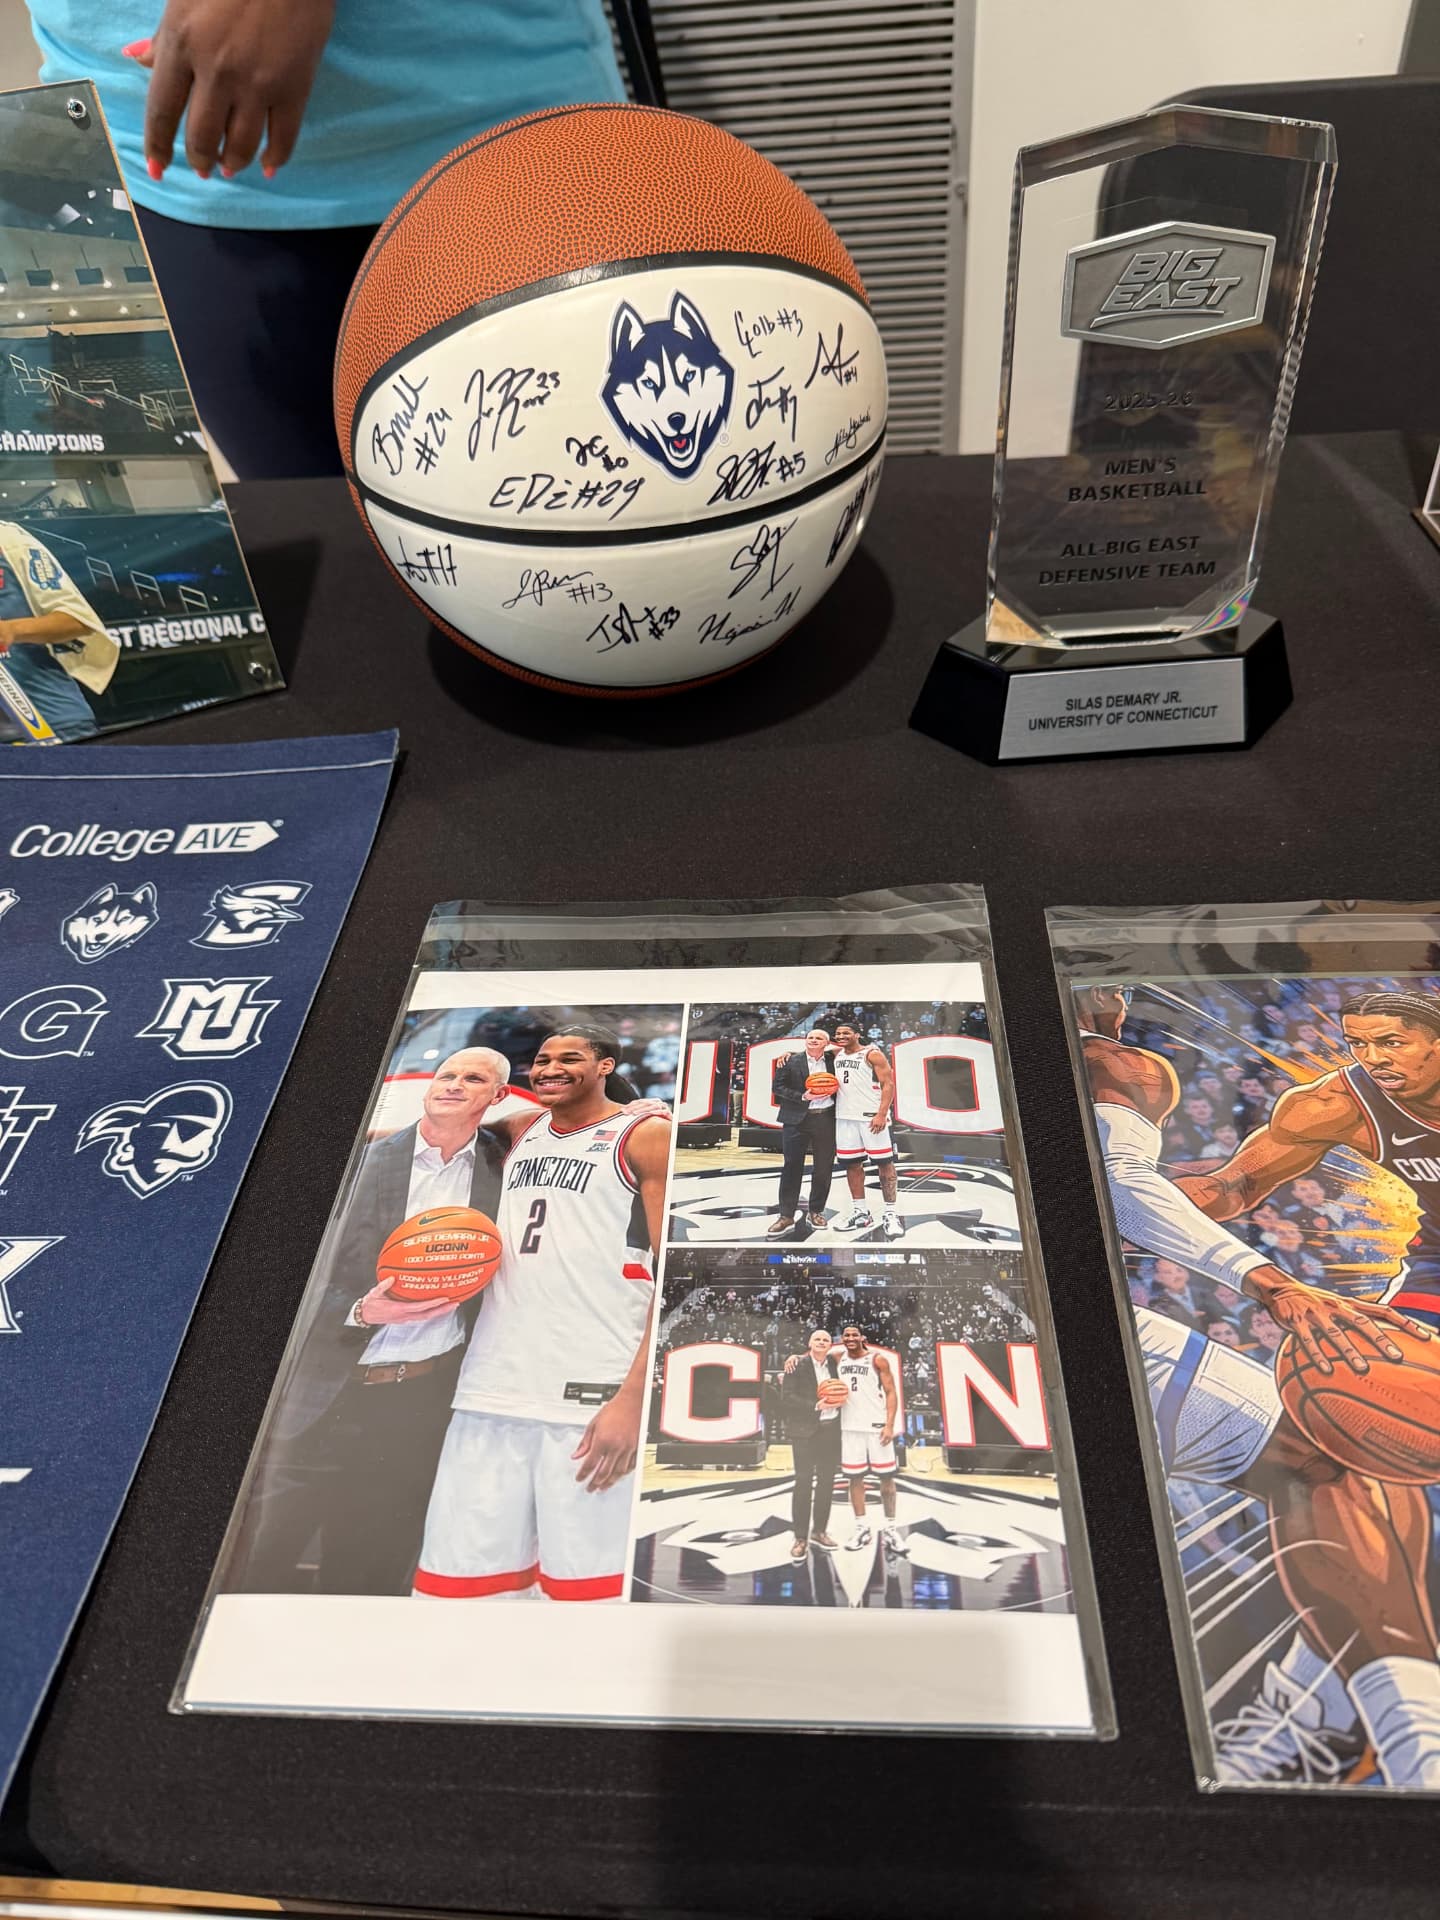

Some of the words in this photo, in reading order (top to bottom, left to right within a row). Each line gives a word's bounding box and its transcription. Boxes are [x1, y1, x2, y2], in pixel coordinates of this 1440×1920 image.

[1118, 248, 1224, 285] BIG
[1100, 277, 1241, 313] EAST
[1103, 391, 1193, 412] 2025-26
[412, 407, 453, 476] #24
[1104, 456, 1177, 476] MEN'S
[1068, 479, 1207, 503] BASKETBALL
[1060, 539, 1141, 558] ALL-BIG
[1149, 535, 1200, 553] EAST
[1039, 564, 1151, 586] DEFENSIVE
[1157, 560, 1217, 578] TEAM
[565, 582, 613, 604] #13
[138, 614, 249, 648] REGIONAL
[1065, 697, 1103, 712] SILAS
[1105, 692, 1161, 709] DEMARY
[1163, 690, 1183, 704] JR.
[1028, 713, 1103, 731] UNIVERSITY
[1106, 711, 1124, 725] OF
[1127, 705, 1218, 724] CONNECTICUT
[10, 823, 176, 862] College
[184, 825, 256, 850] AVE
[843, 1070, 850, 1084] 2
[518, 1198, 547, 1255] 2
[425, 1243, 469, 1254] UCONN
[399, 1273, 426, 1283] UCONN
[850, 1376, 858, 1392] 2
[935, 1342, 1053, 1451] N
